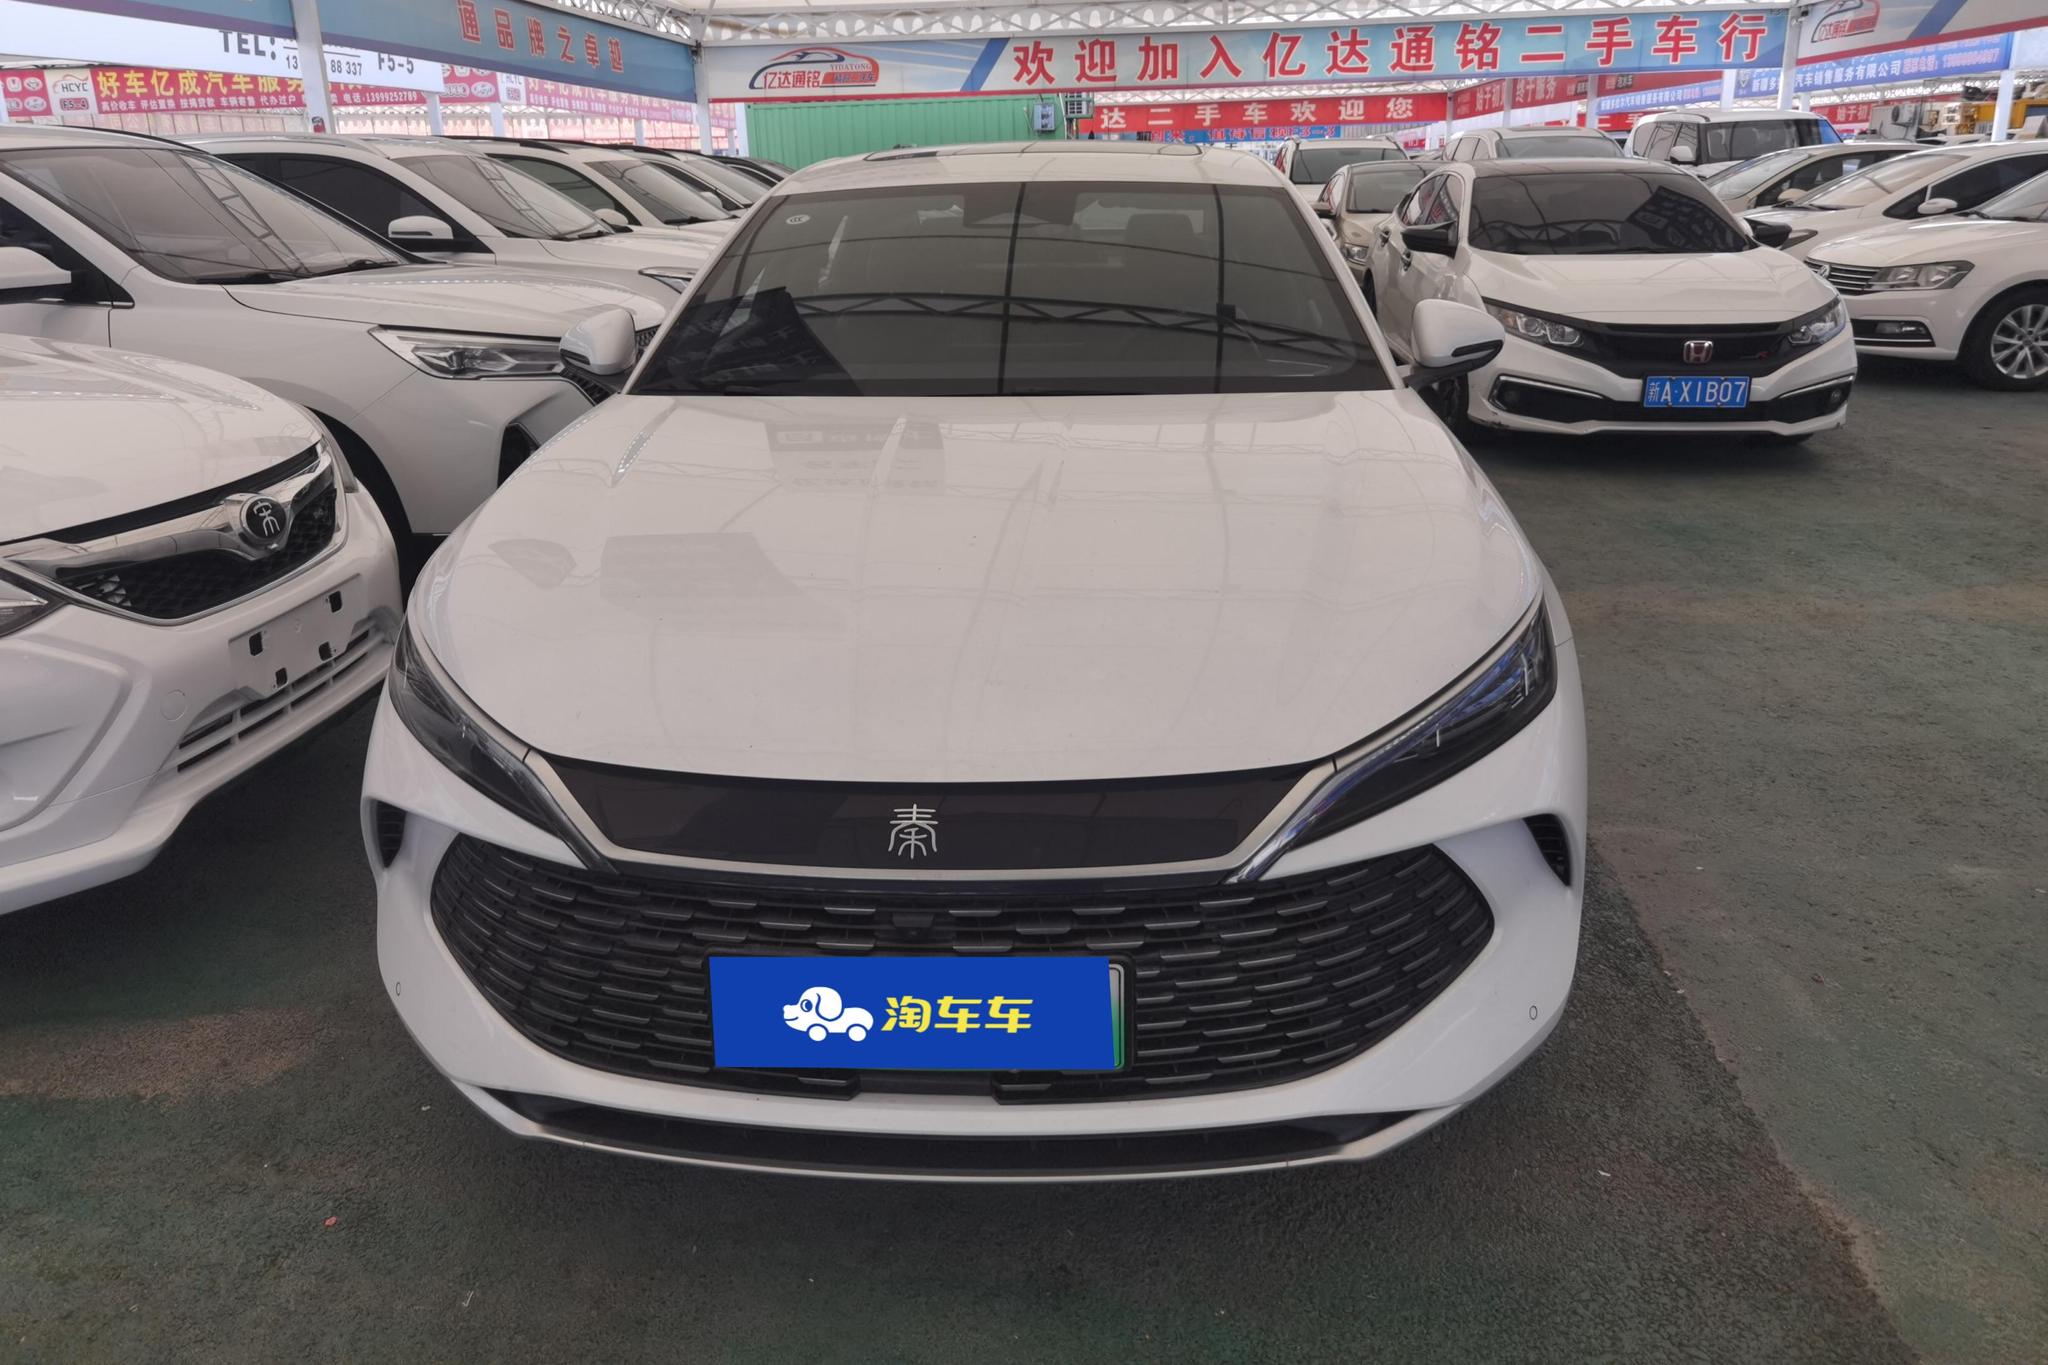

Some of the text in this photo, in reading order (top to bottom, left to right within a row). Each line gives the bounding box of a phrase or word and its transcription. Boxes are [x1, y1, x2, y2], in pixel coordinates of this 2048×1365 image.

[1013, 11, 1767, 86] 欢迎加入亿达通铭二手车行
[764, 70, 821, 89] 亿达通铭
[1101, 98, 1413, 129] 达二手车欢迎您
